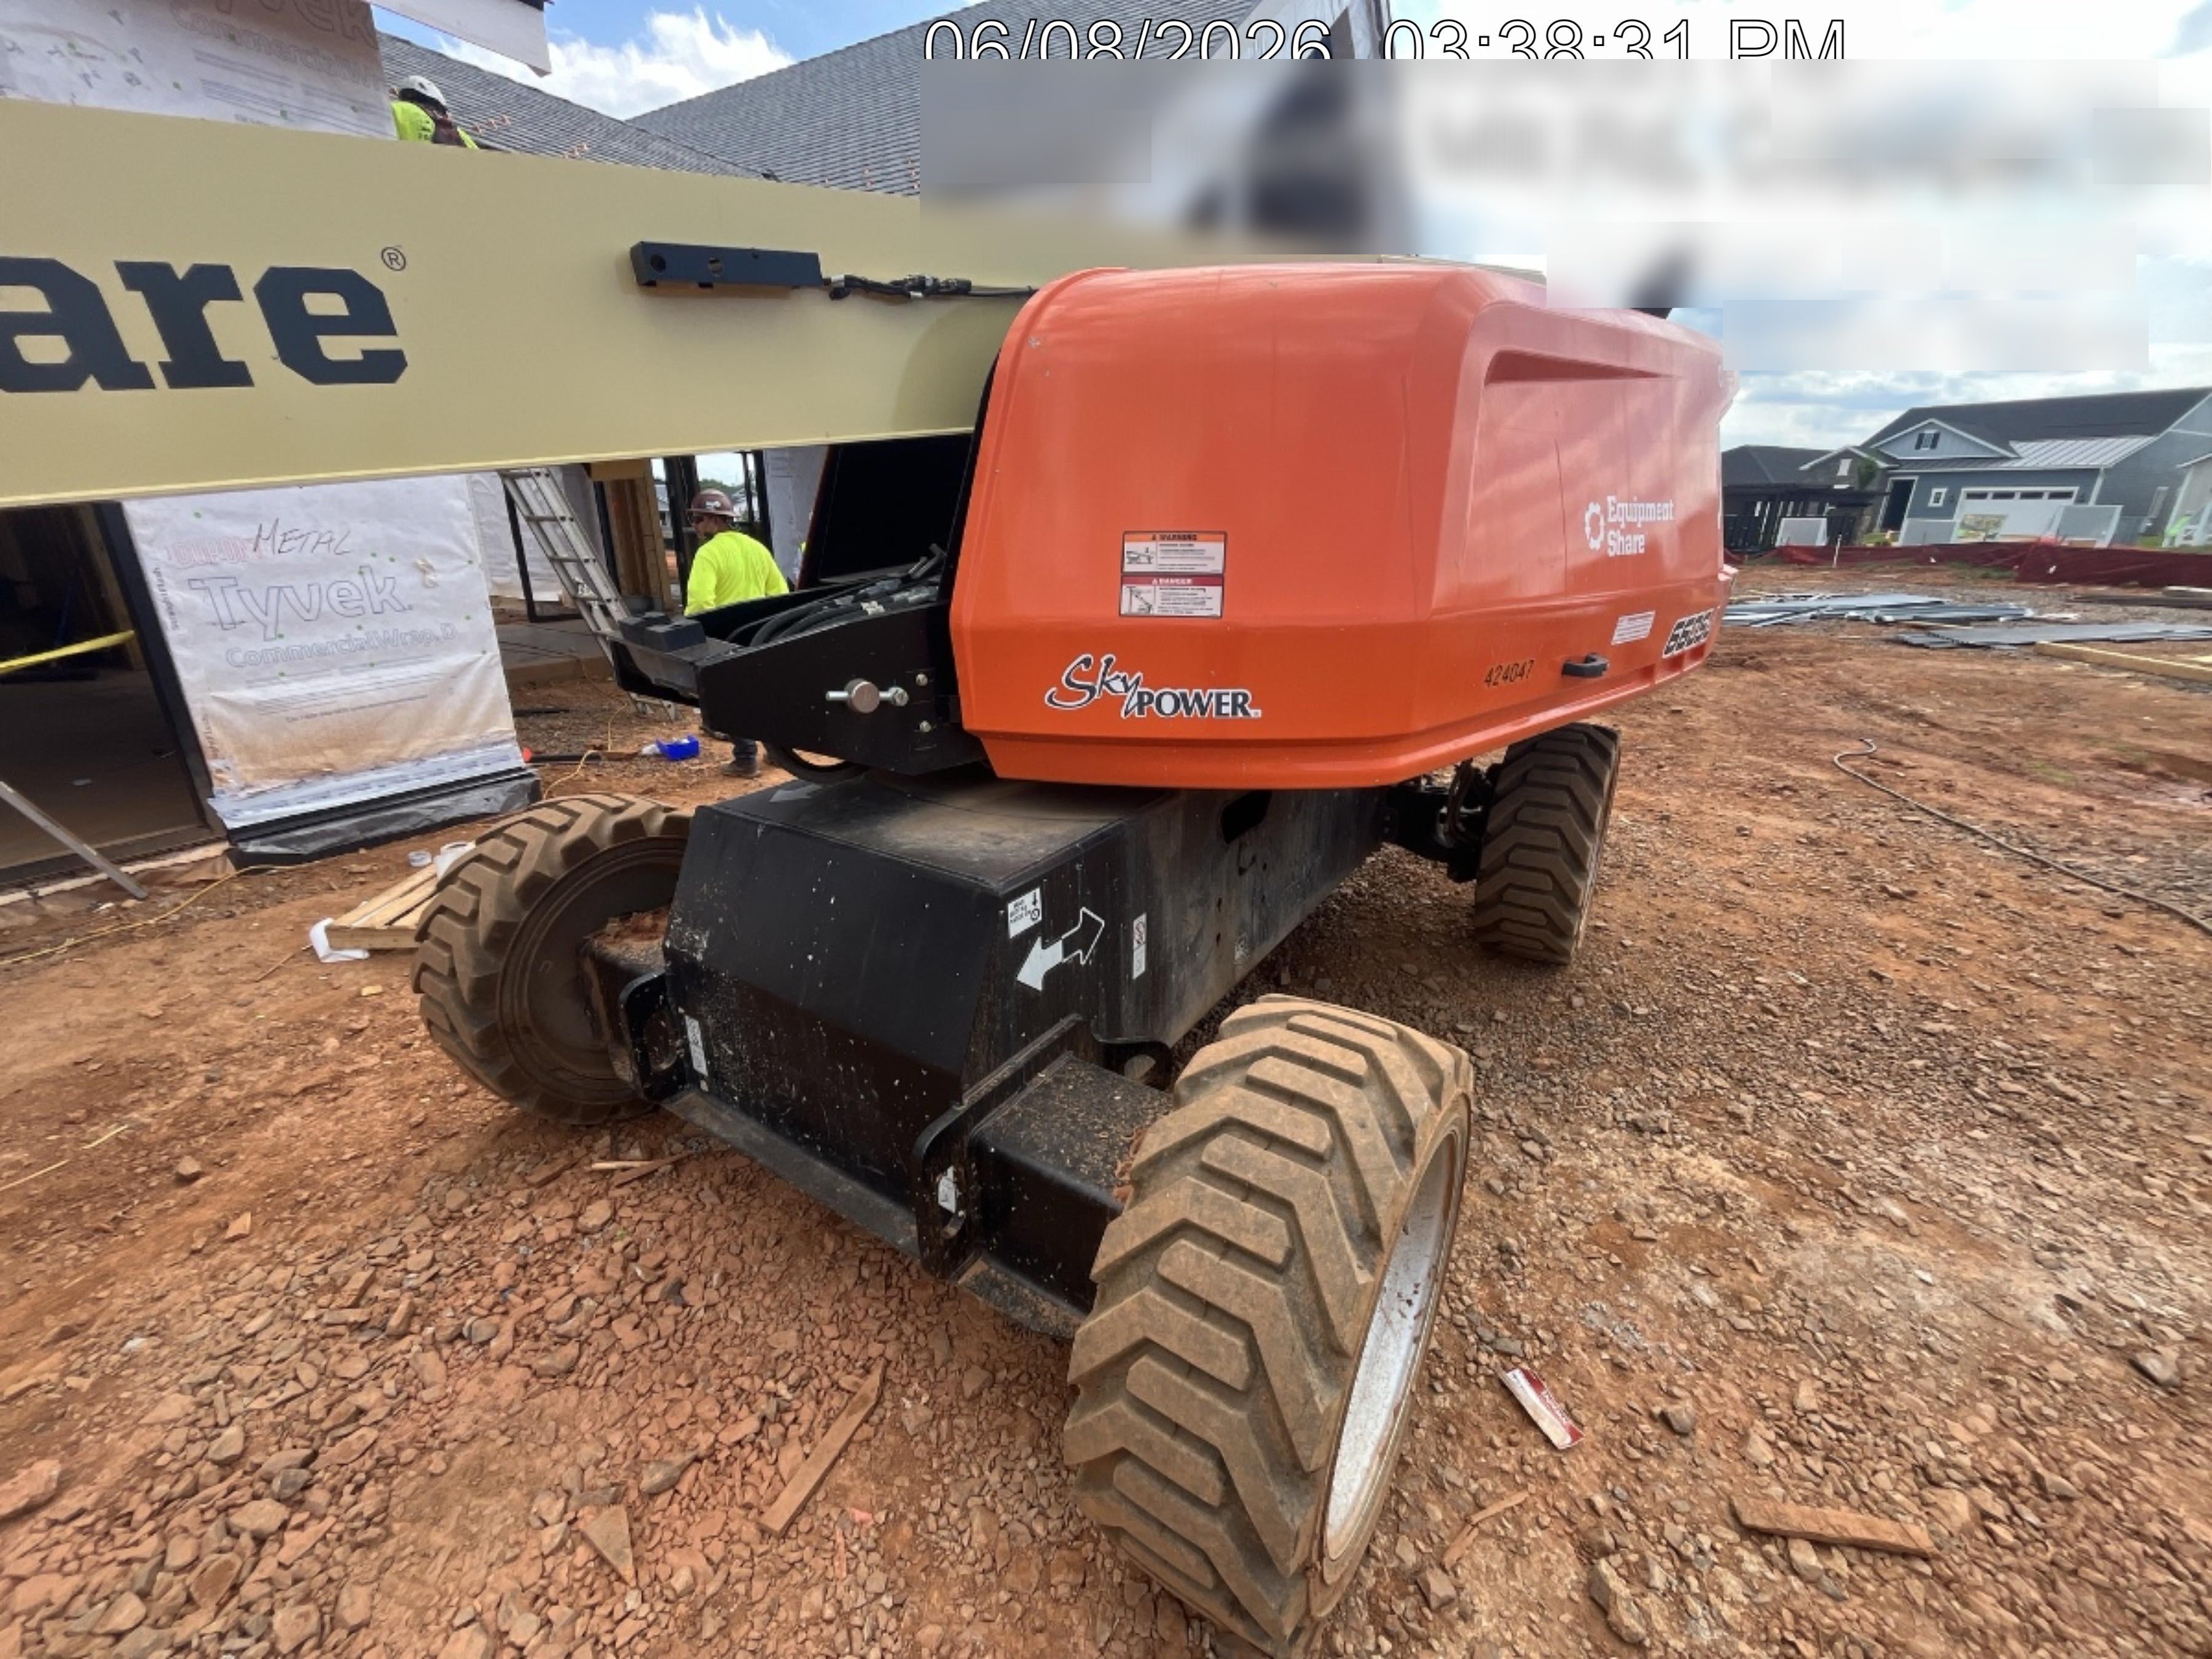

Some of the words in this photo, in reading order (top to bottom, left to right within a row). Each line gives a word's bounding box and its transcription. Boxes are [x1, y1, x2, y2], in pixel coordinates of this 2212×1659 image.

[1607, 495, 1674, 528] Equipment
[253, 517, 352, 555] METAL
[1607, 530, 1645, 557] Share
[187, 565, 407, 641] Tyvek
[1484, 659, 1535, 688] 424047
